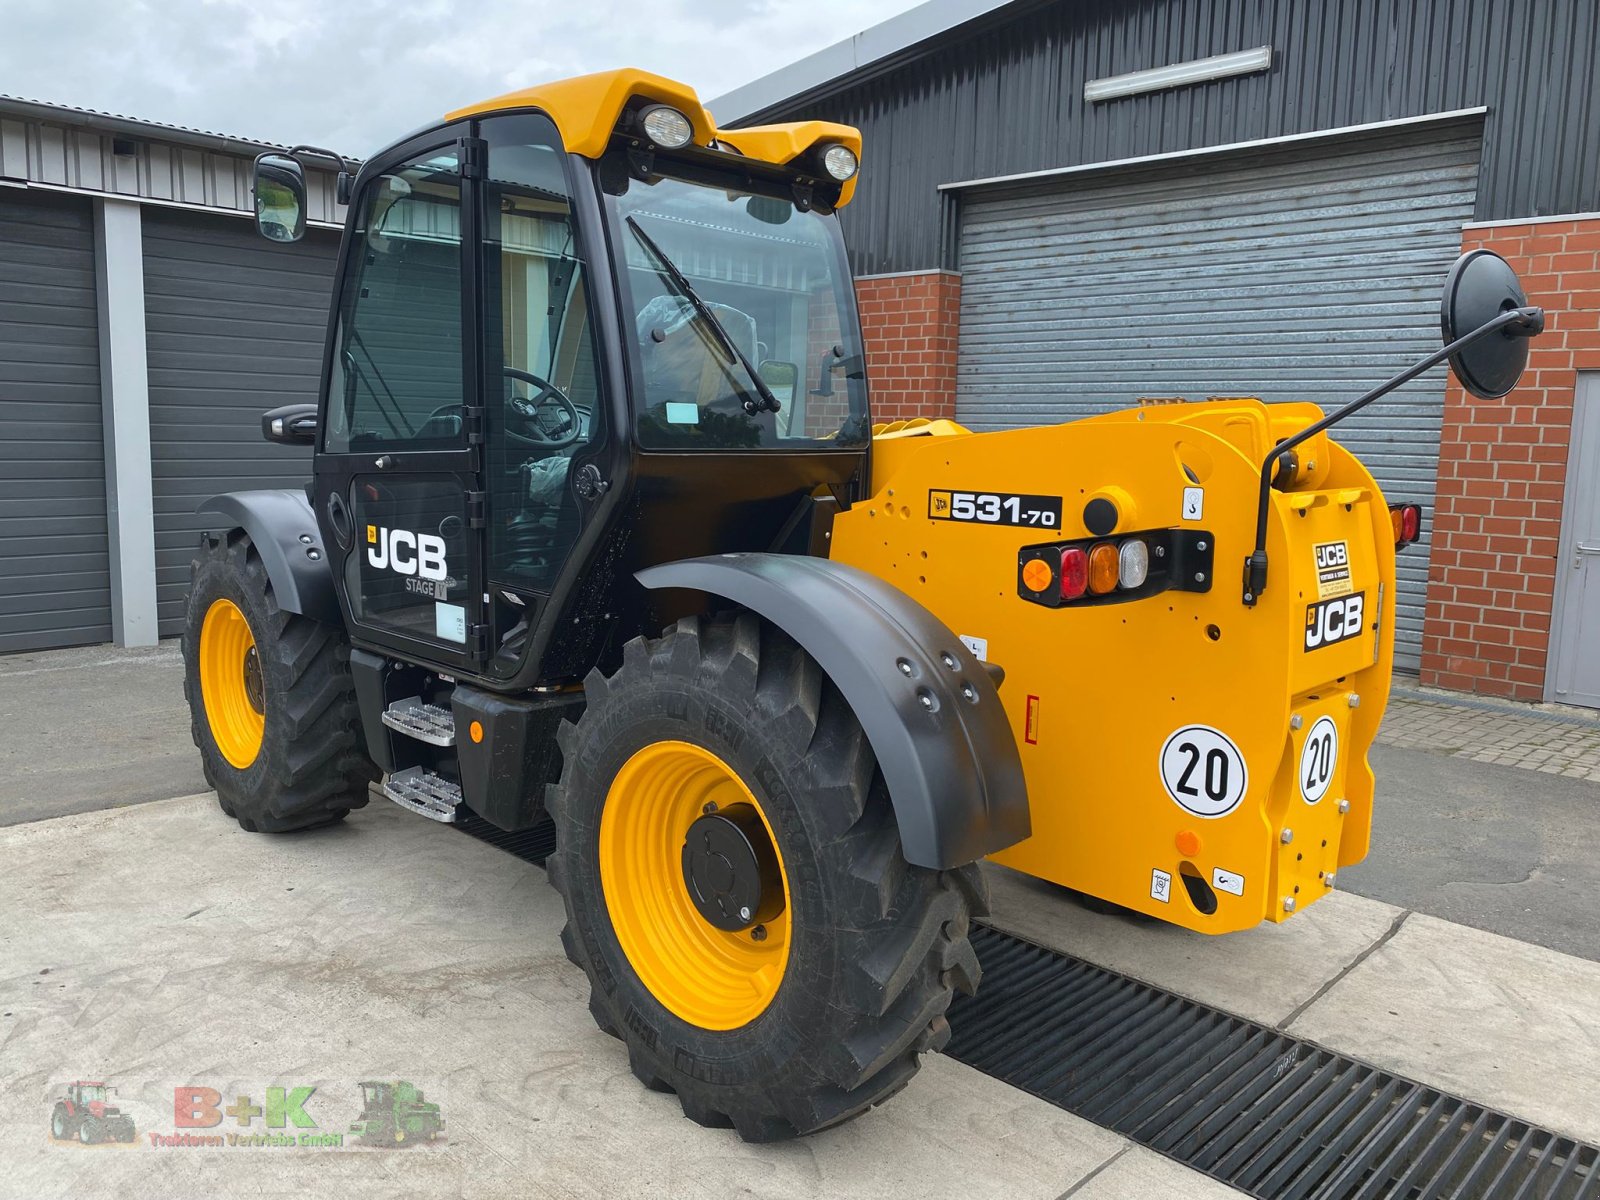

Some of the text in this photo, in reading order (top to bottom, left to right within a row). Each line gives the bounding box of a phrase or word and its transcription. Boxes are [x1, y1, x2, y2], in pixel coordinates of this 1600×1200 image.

[952, 493, 1055, 526] 531-70
[367, 526, 448, 581] JCB
[1317, 544, 1347, 567] JCB
[406, 578, 434, 596] STAGE
[1306, 595, 1363, 647] JCB
[1177, 742, 1229, 801] 20
[1306, 733, 1331, 790] 20
